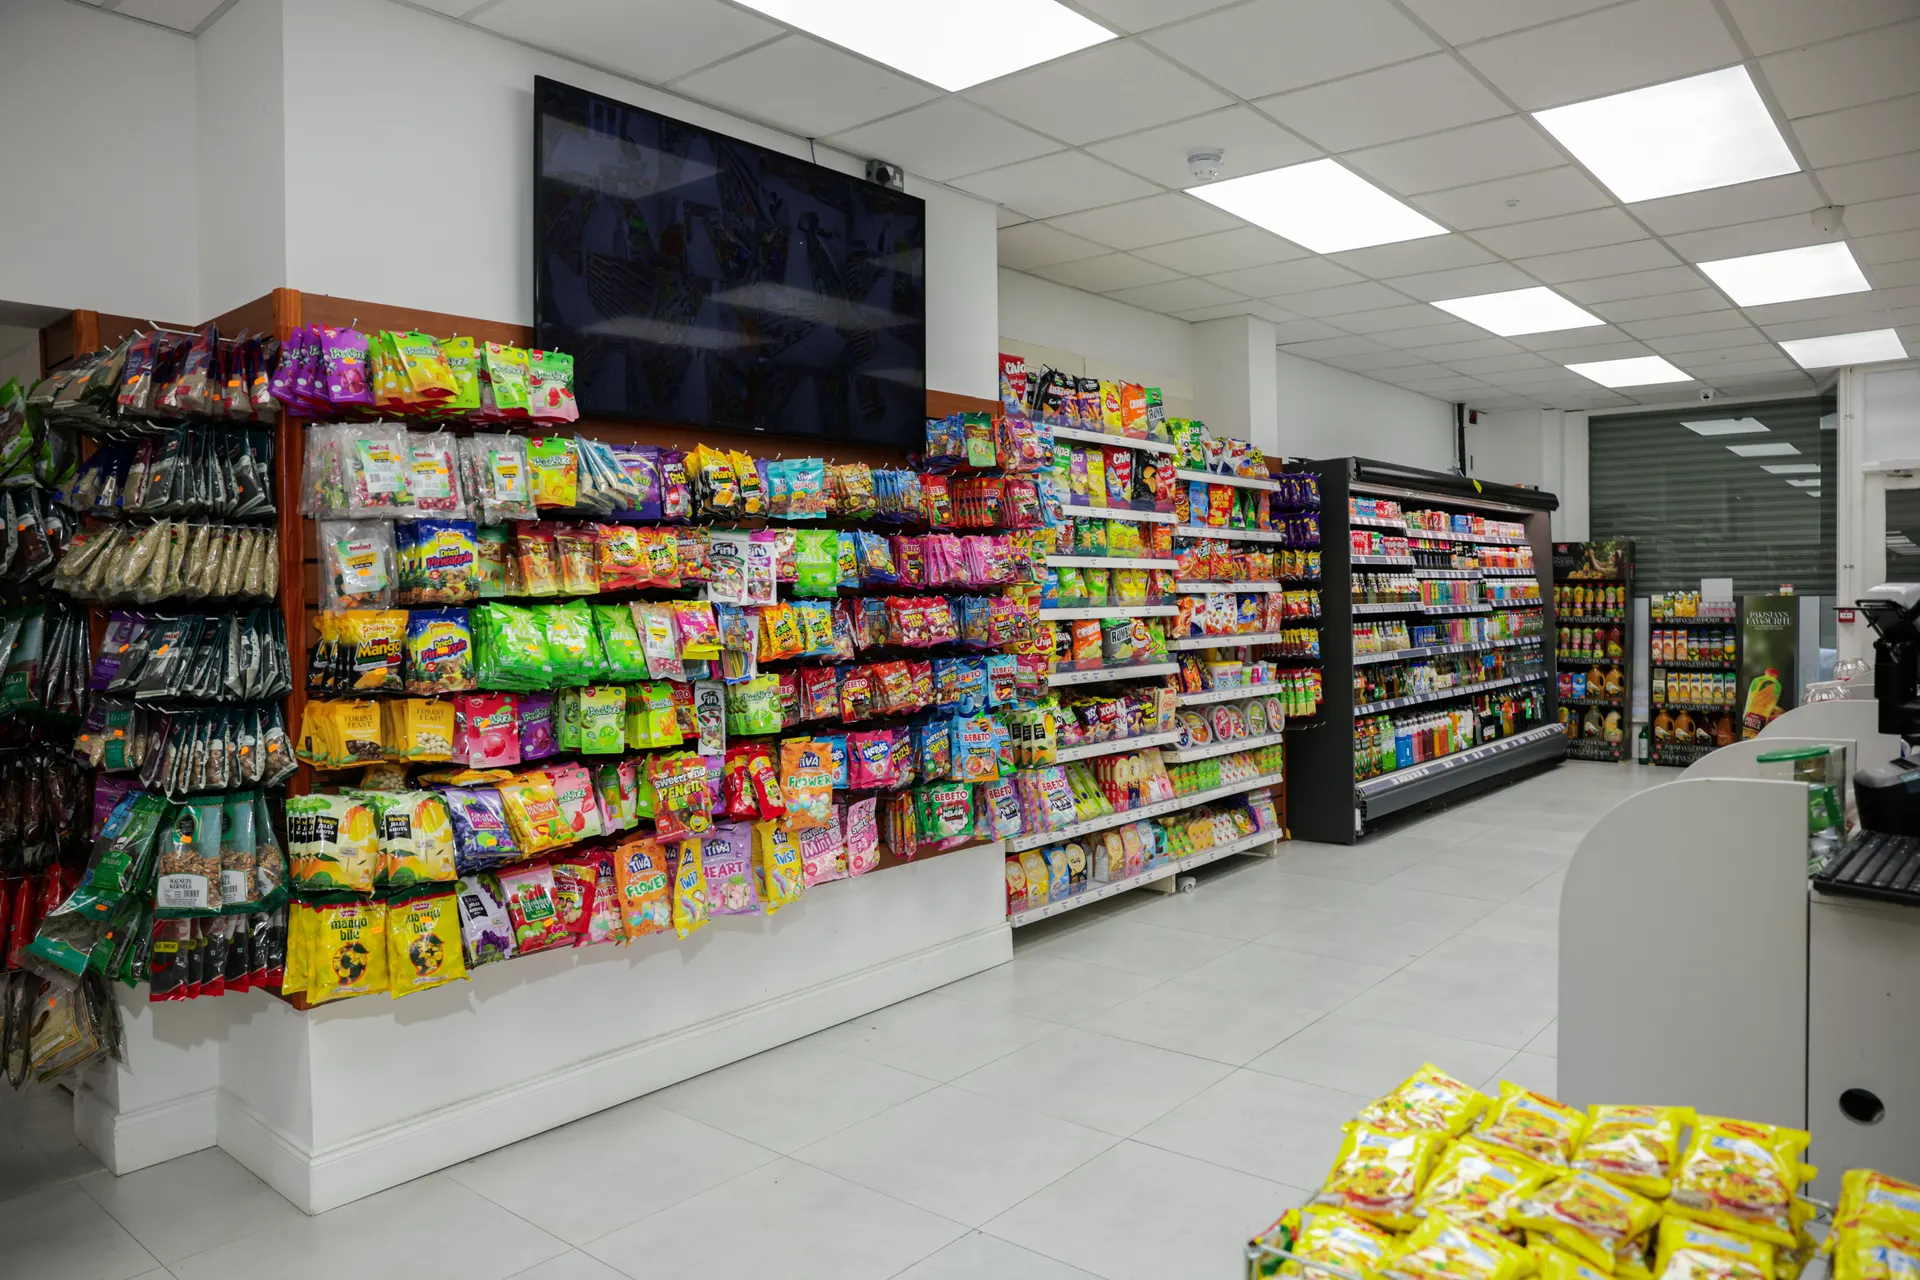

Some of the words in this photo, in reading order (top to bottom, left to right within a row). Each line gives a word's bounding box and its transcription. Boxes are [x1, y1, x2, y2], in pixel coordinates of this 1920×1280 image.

[1005, 361, 1026, 374] Chio
[1071, 453, 1083, 463] ipa
[1113, 451, 1131, 465] Chio
[1158, 458, 1171, 467] hio
[440, 548, 459, 557] Dried
[713, 543, 737, 557] Fini
[426, 552, 473, 569] Pineapple
[1746, 617, 1792, 625] FAVOURITE
[357, 640, 401, 657] Mango
[433, 637, 453, 649] Dried
[416, 708, 445, 716] FOREST
[587, 704, 621, 716] Peelerz
[344, 714, 374, 724] FOREST
[347, 720, 372, 728] FEAST
[419, 713, 443, 722] FEAST
[964, 732, 991, 742] BEBETO
[863, 742, 888, 759] Nerds
[798, 753, 820, 768] TIVA
[788, 773, 832, 789] FLOWER
[557, 788, 587, 804] eelerz
[660, 780, 702, 801] PENCIL
[934, 790, 969, 802] BEBETO
[388, 815, 409, 823] Mango
[390, 820, 406, 828] JELLY
[318, 822, 334, 831] JELLY
[705, 840, 731, 856] TIVA
[803, 833, 832, 859] Mini
[774, 849, 796, 865] TWIST
[629, 855, 652, 873] TIVA
[702, 861, 744, 879] HEART
[626, 873, 668, 898] FLOWER
[331, 917, 368, 932] mango
[413, 921, 434, 934] bite
[340, 929, 360, 940] bite
